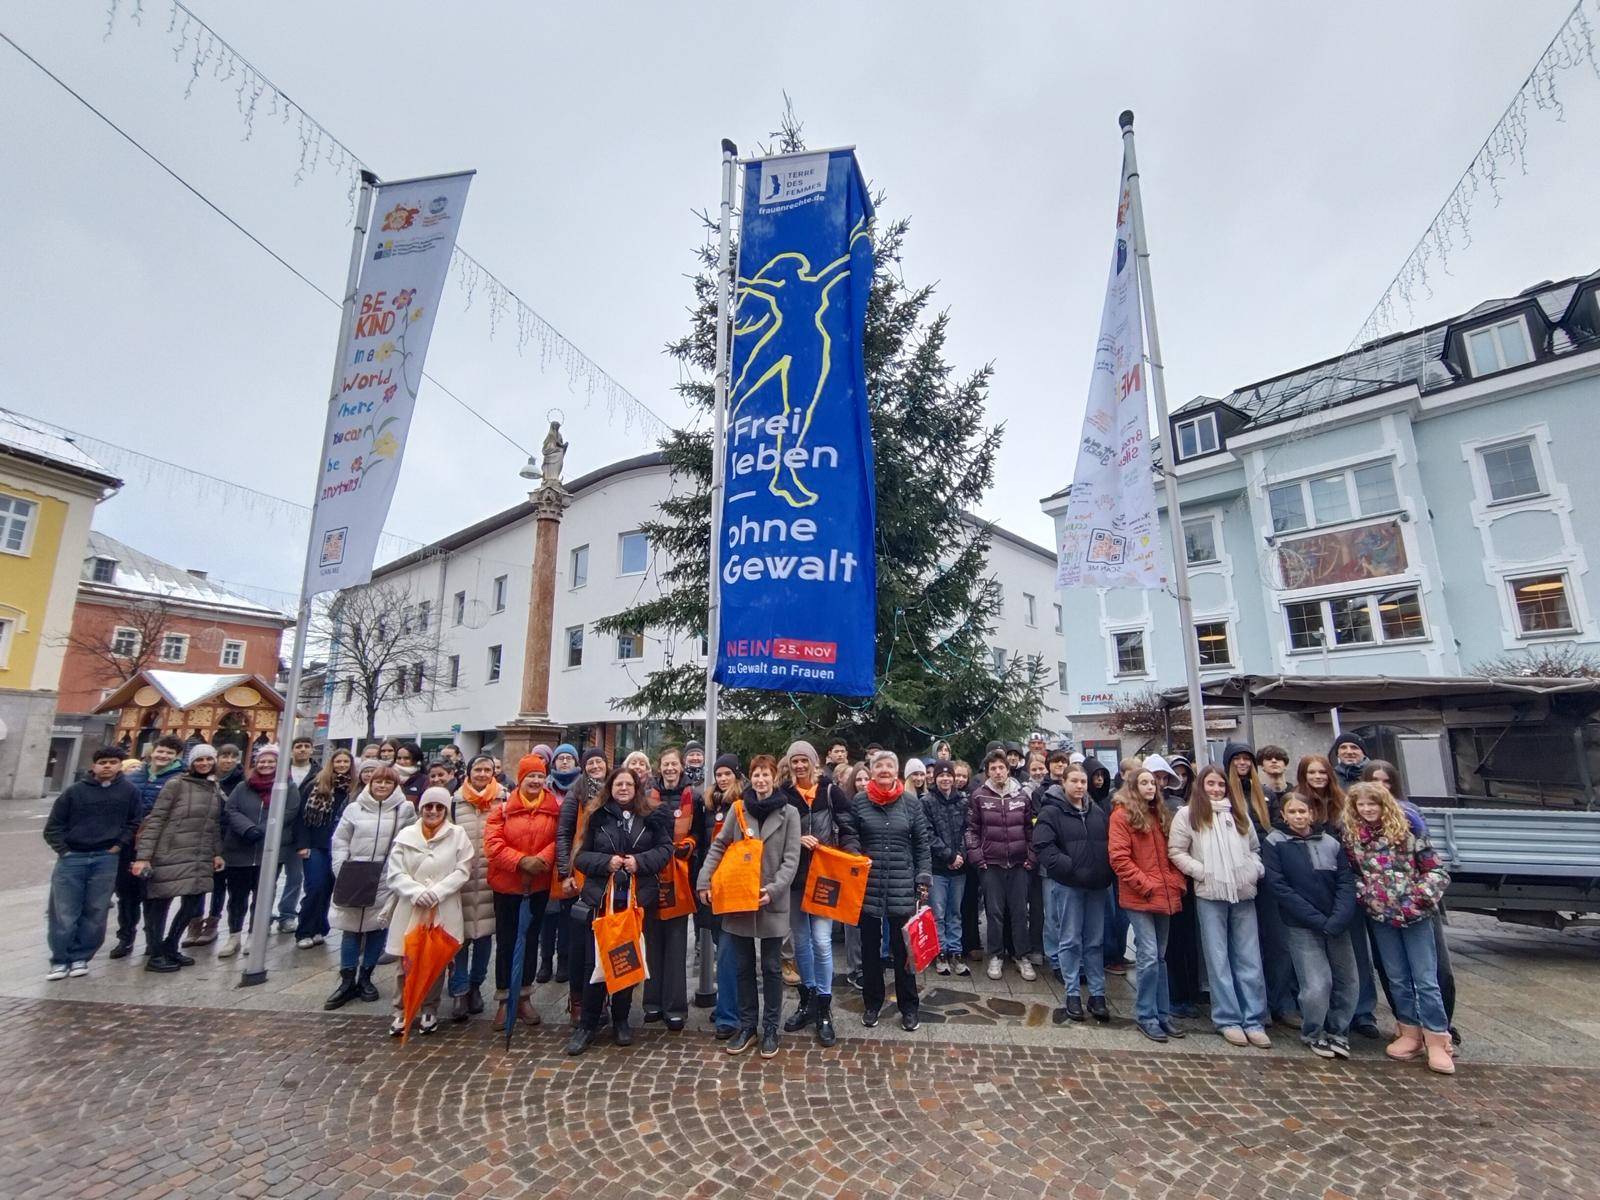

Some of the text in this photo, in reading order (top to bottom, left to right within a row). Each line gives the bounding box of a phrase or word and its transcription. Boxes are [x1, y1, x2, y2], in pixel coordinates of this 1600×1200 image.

[787, 168, 815, 179] TERRE
[786, 181, 822, 196] FEMMES
[758, 194, 825, 215] frauenrechte.de
[360, 291, 387, 315] BE
[355, 311, 396, 339] KIND
[734, 407, 802, 446] Frei
[327, 458, 340, 472] be
[732, 443, 838, 480] leben
[728, 515, 817, 548] ohne
[723, 549, 857, 584] Gewalt
[727, 639, 770, 657] NEIN
[778, 644, 831, 657] 25. NOV
[728, 662, 835, 680] zu Gewalt an Frauen
[1080, 693, 1114, 702] RE/MAX
